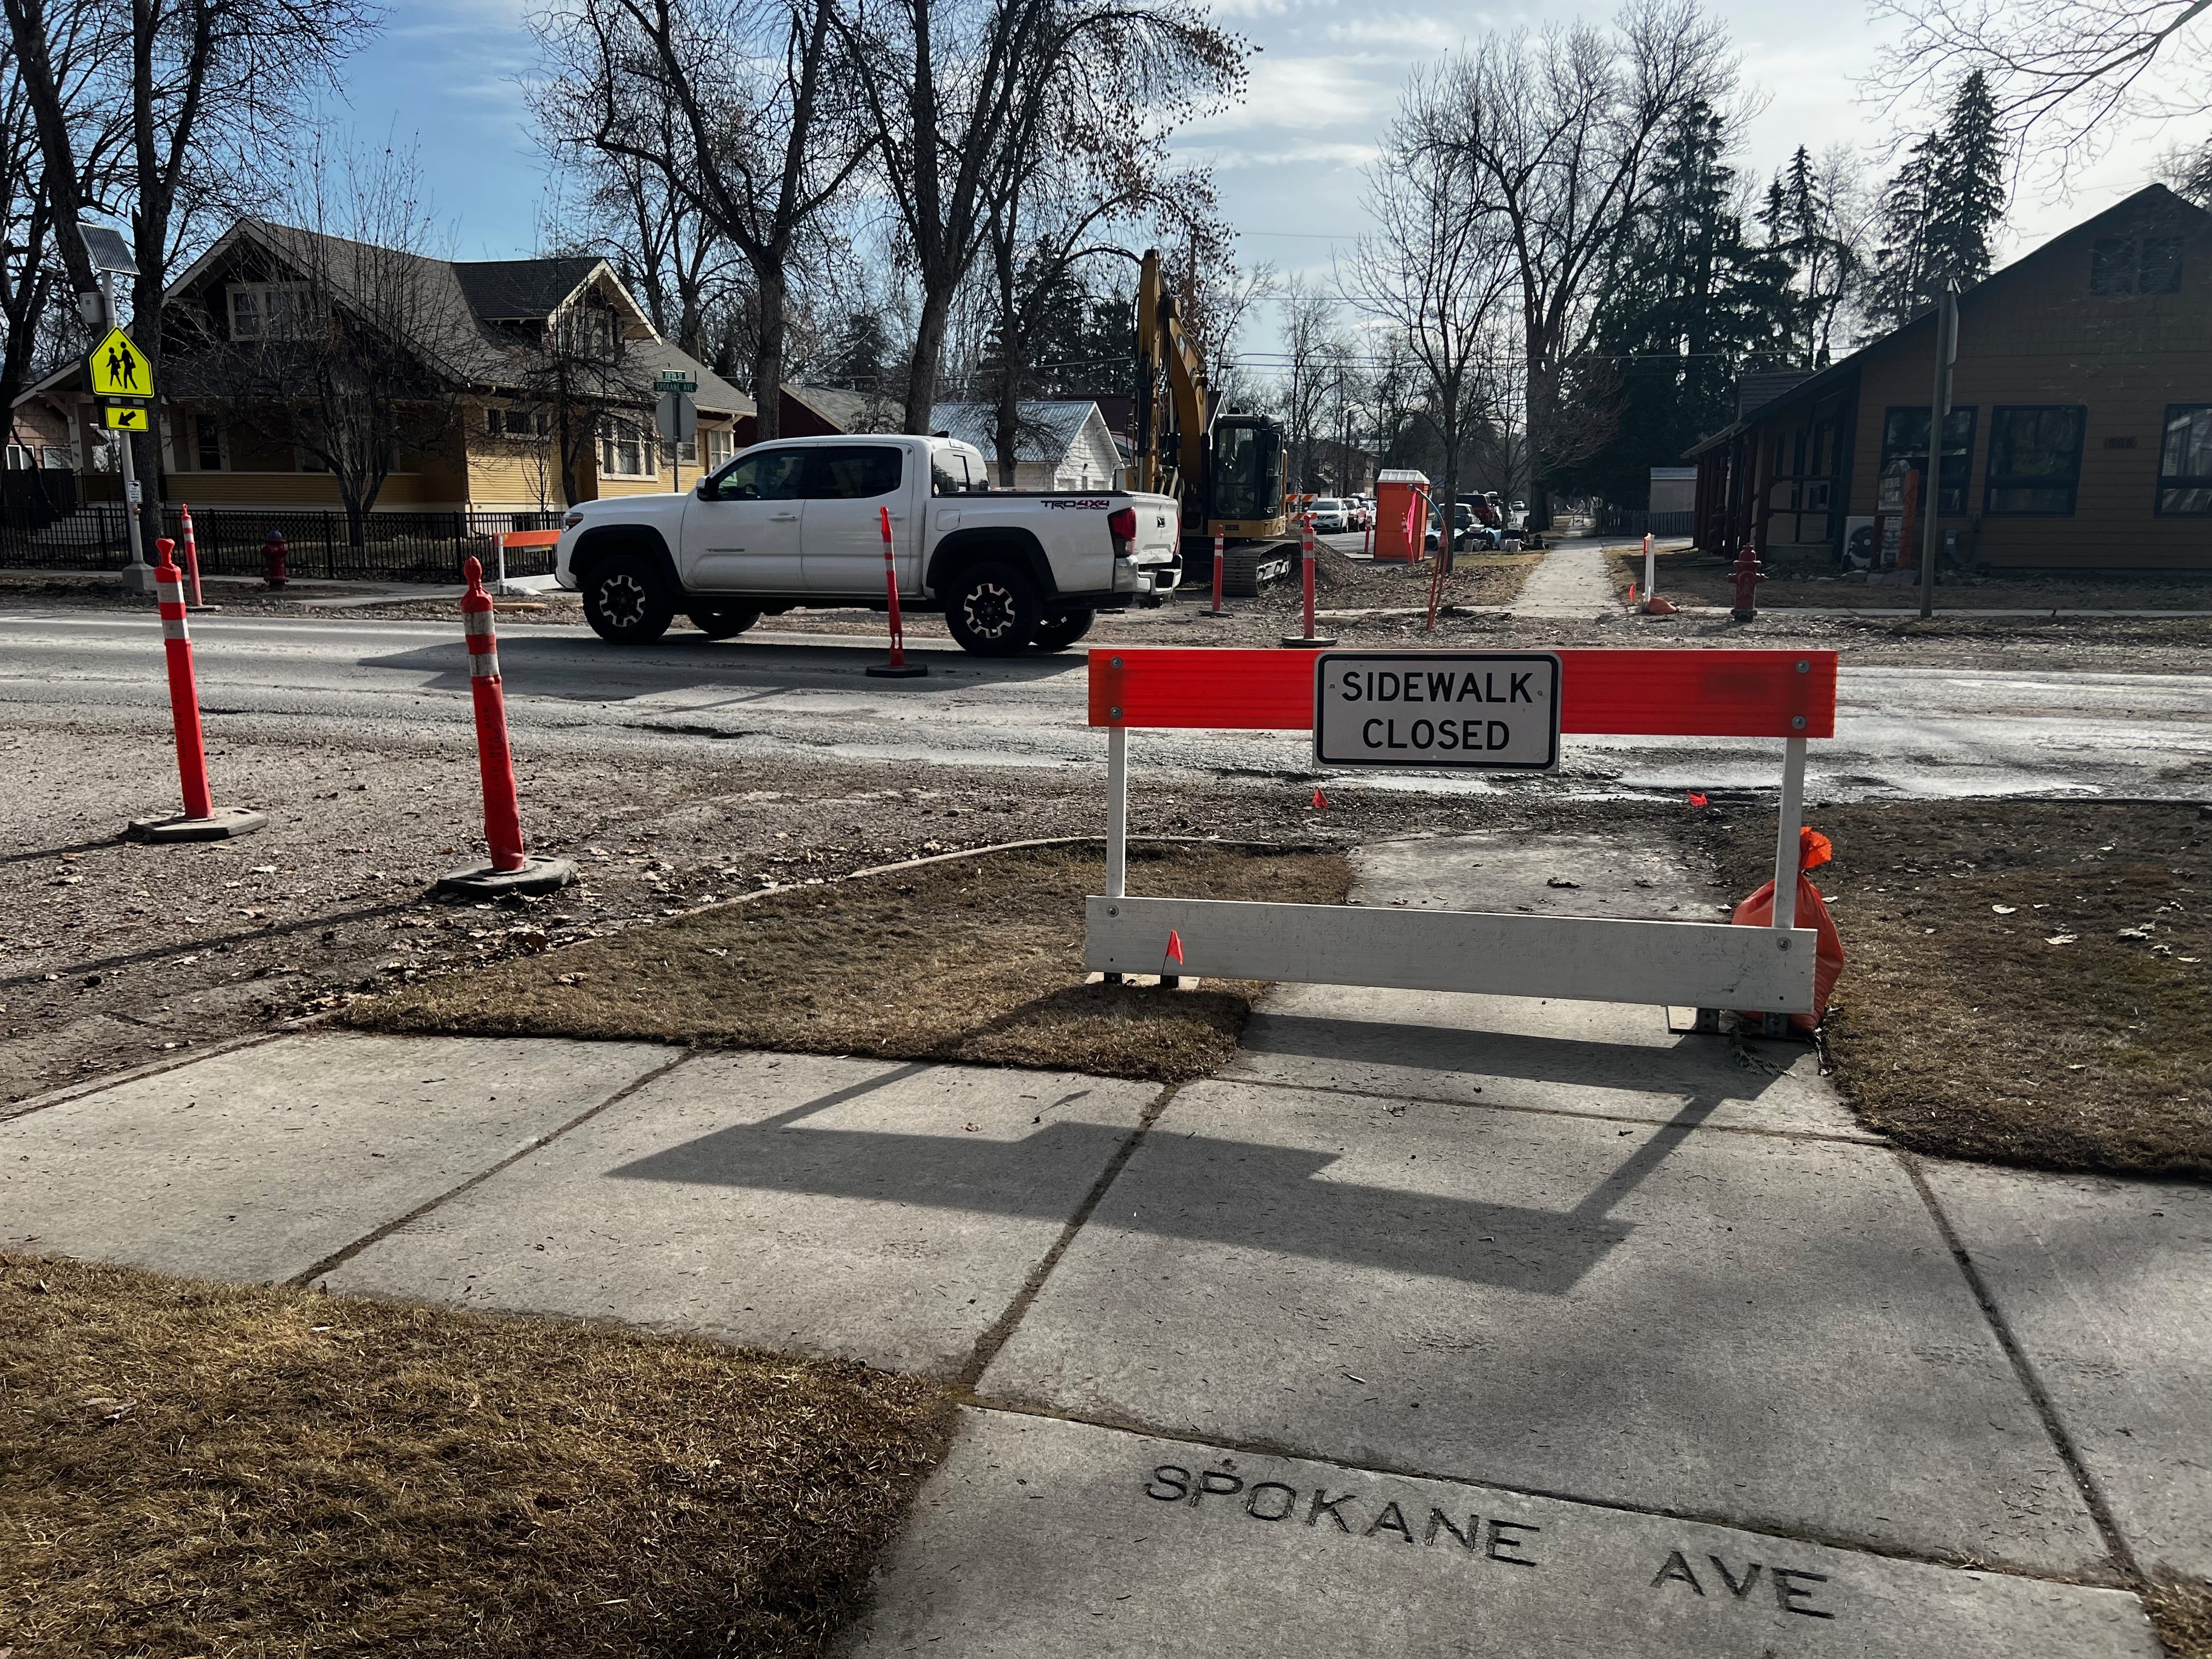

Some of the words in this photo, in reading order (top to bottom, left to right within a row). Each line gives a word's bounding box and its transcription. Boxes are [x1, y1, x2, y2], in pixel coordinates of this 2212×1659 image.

[1341, 671, 1533, 703] SIDEWALK
[1363, 719, 1510, 750] CLOSED
[1143, 1465, 1541, 1567] SPOKANE
[1649, 1550, 1836, 1620] AVE
